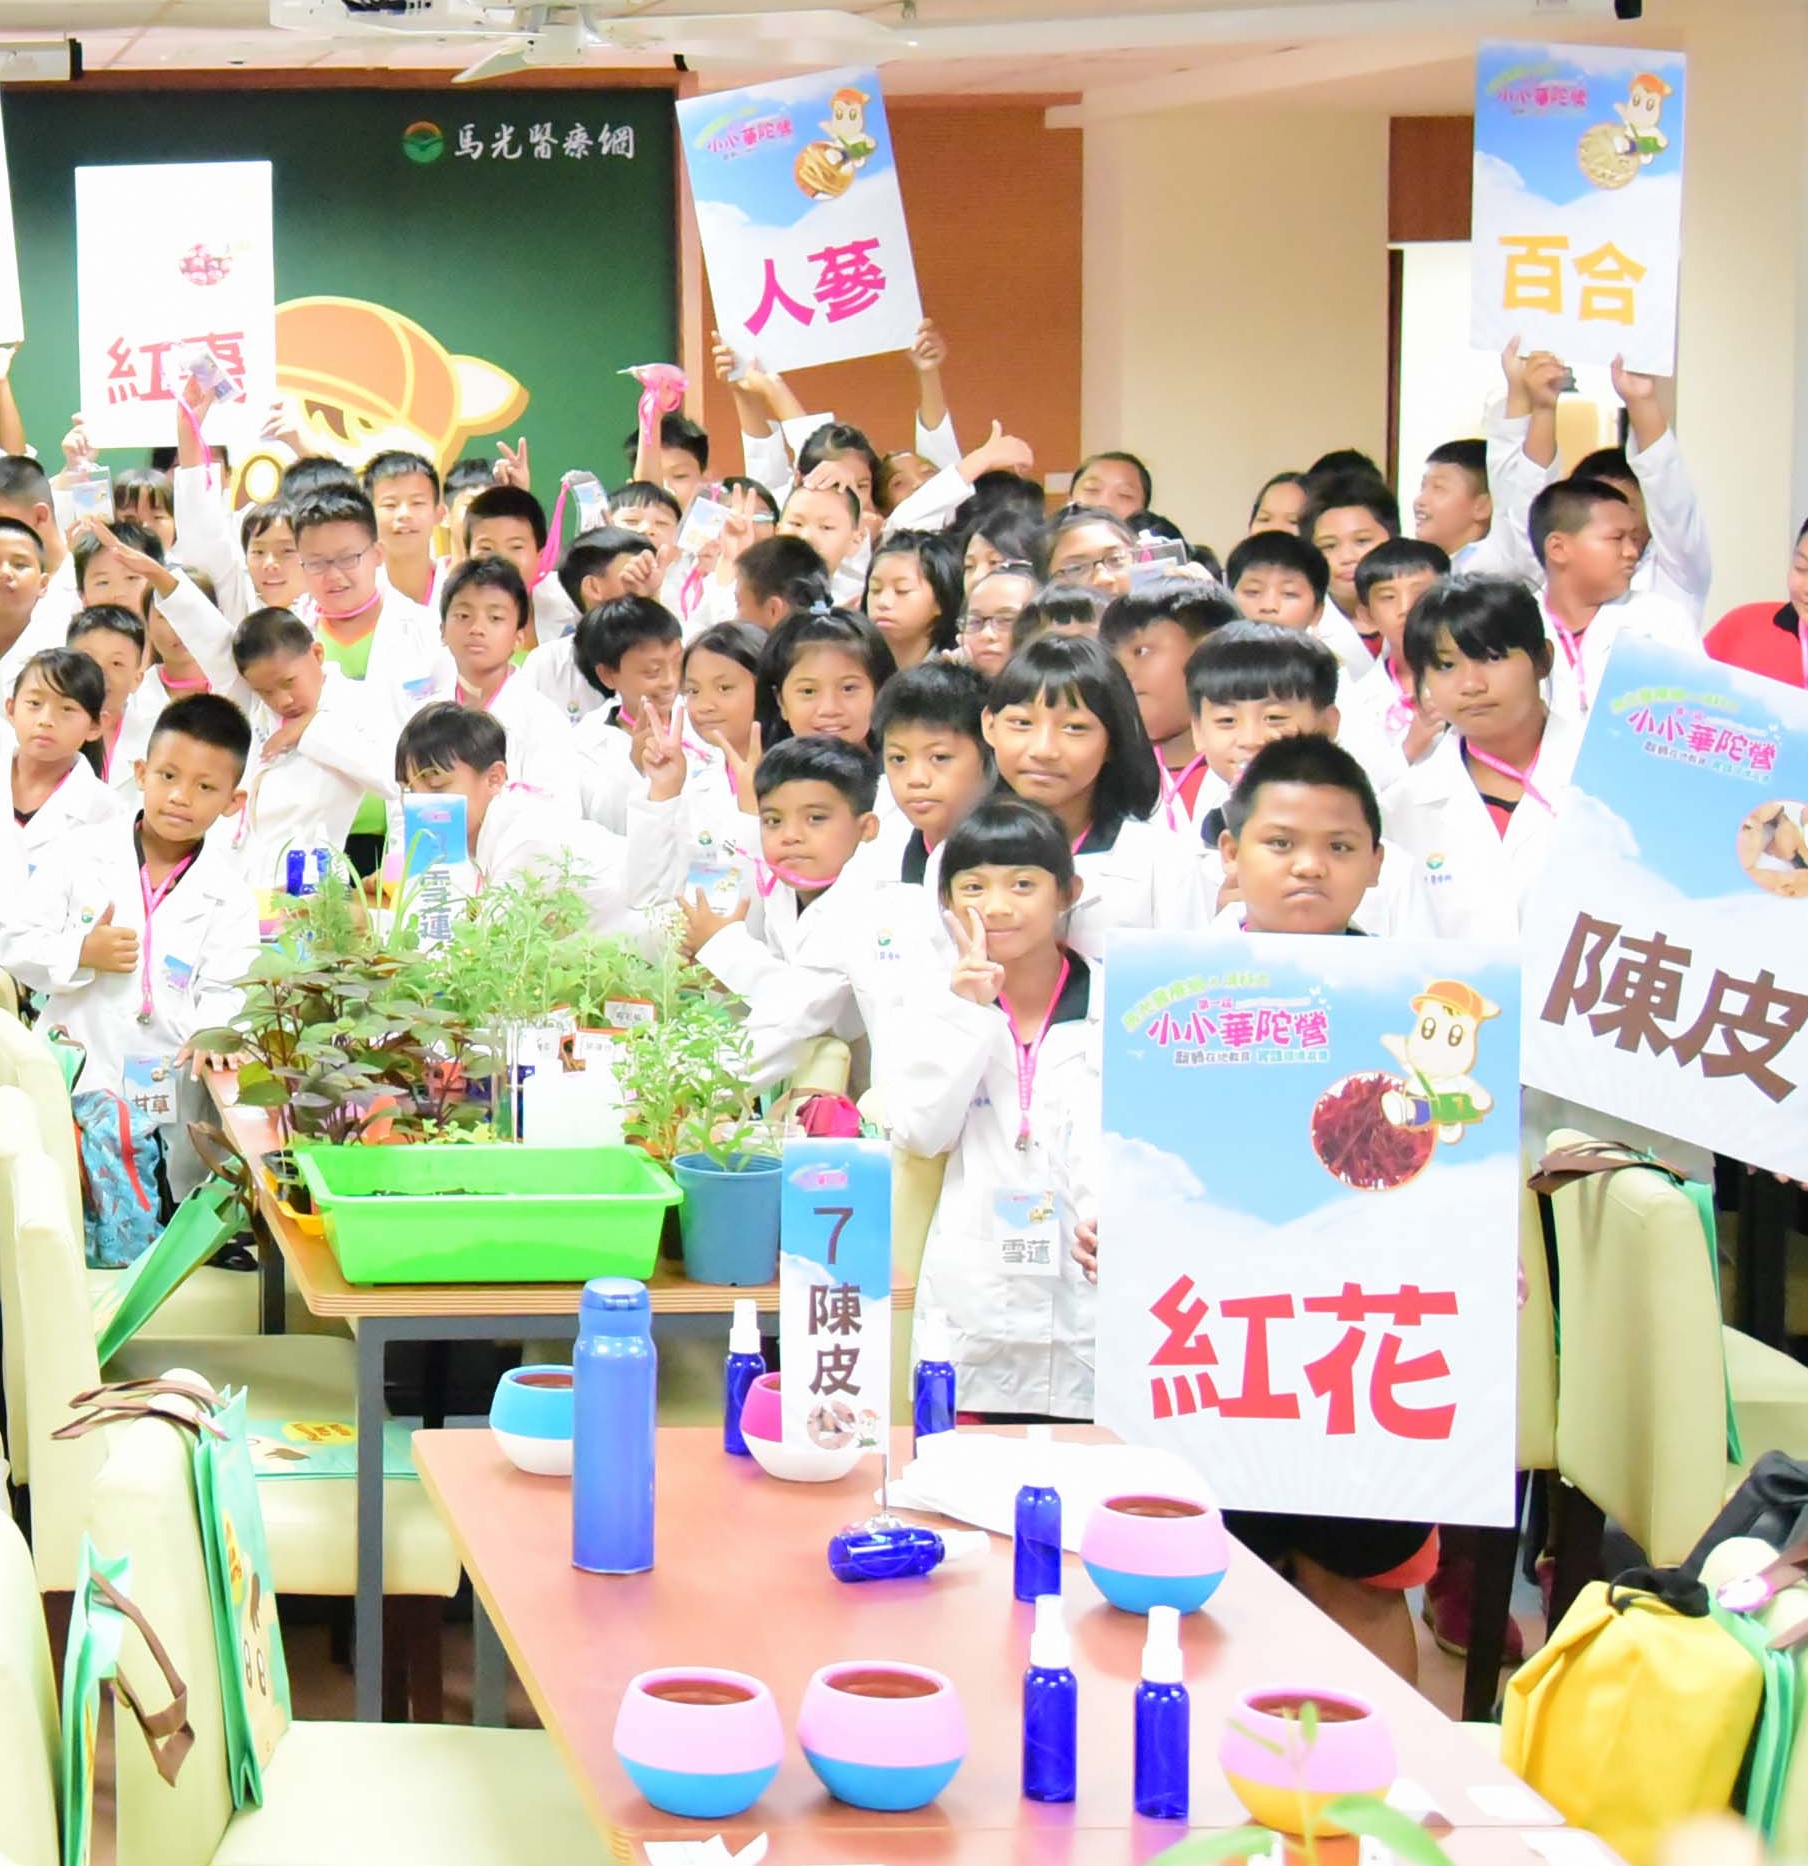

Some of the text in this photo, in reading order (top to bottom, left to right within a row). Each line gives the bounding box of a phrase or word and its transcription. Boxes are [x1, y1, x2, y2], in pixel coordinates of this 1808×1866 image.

[454, 121, 635, 161] 馬光醫療網
[743, 237, 886, 337] 人蔘
[1498, 235, 1648, 326] 百合
[1628, 708, 1777, 771] 小小華陀營
[1147, 1009, 1329, 1049] 小小華陀營
[1540, 912, 1808, 1104] 陳皮
[813, 1207, 854, 1265] 7
[1002, 1238, 1051, 1264] 雪蓮
[808, 1282, 862, 1398] 陳皮
[1148, 1274, 1459, 1440] 紅花
